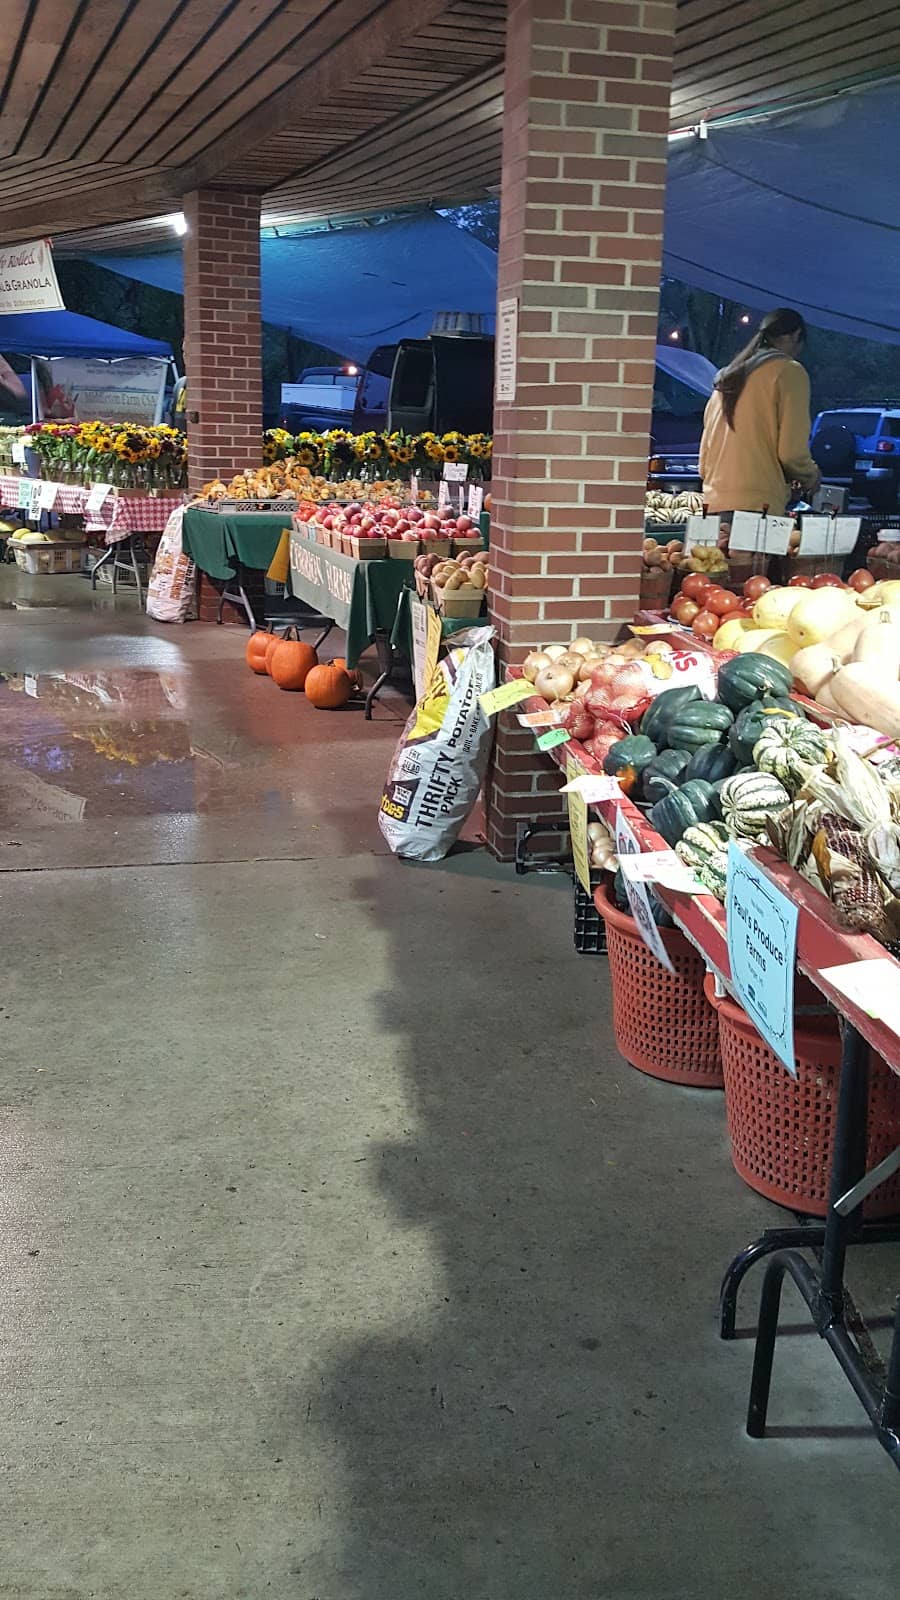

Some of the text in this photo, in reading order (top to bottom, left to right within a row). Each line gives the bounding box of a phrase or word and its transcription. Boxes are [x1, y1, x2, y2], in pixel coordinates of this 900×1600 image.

[414, 750, 456, 828] THRIFTY
[440, 775, 464, 815] PACK
[733, 894, 753, 930] Paul's
[752, 918, 784, 967] Produce
[745, 933, 767, 973] Farms
